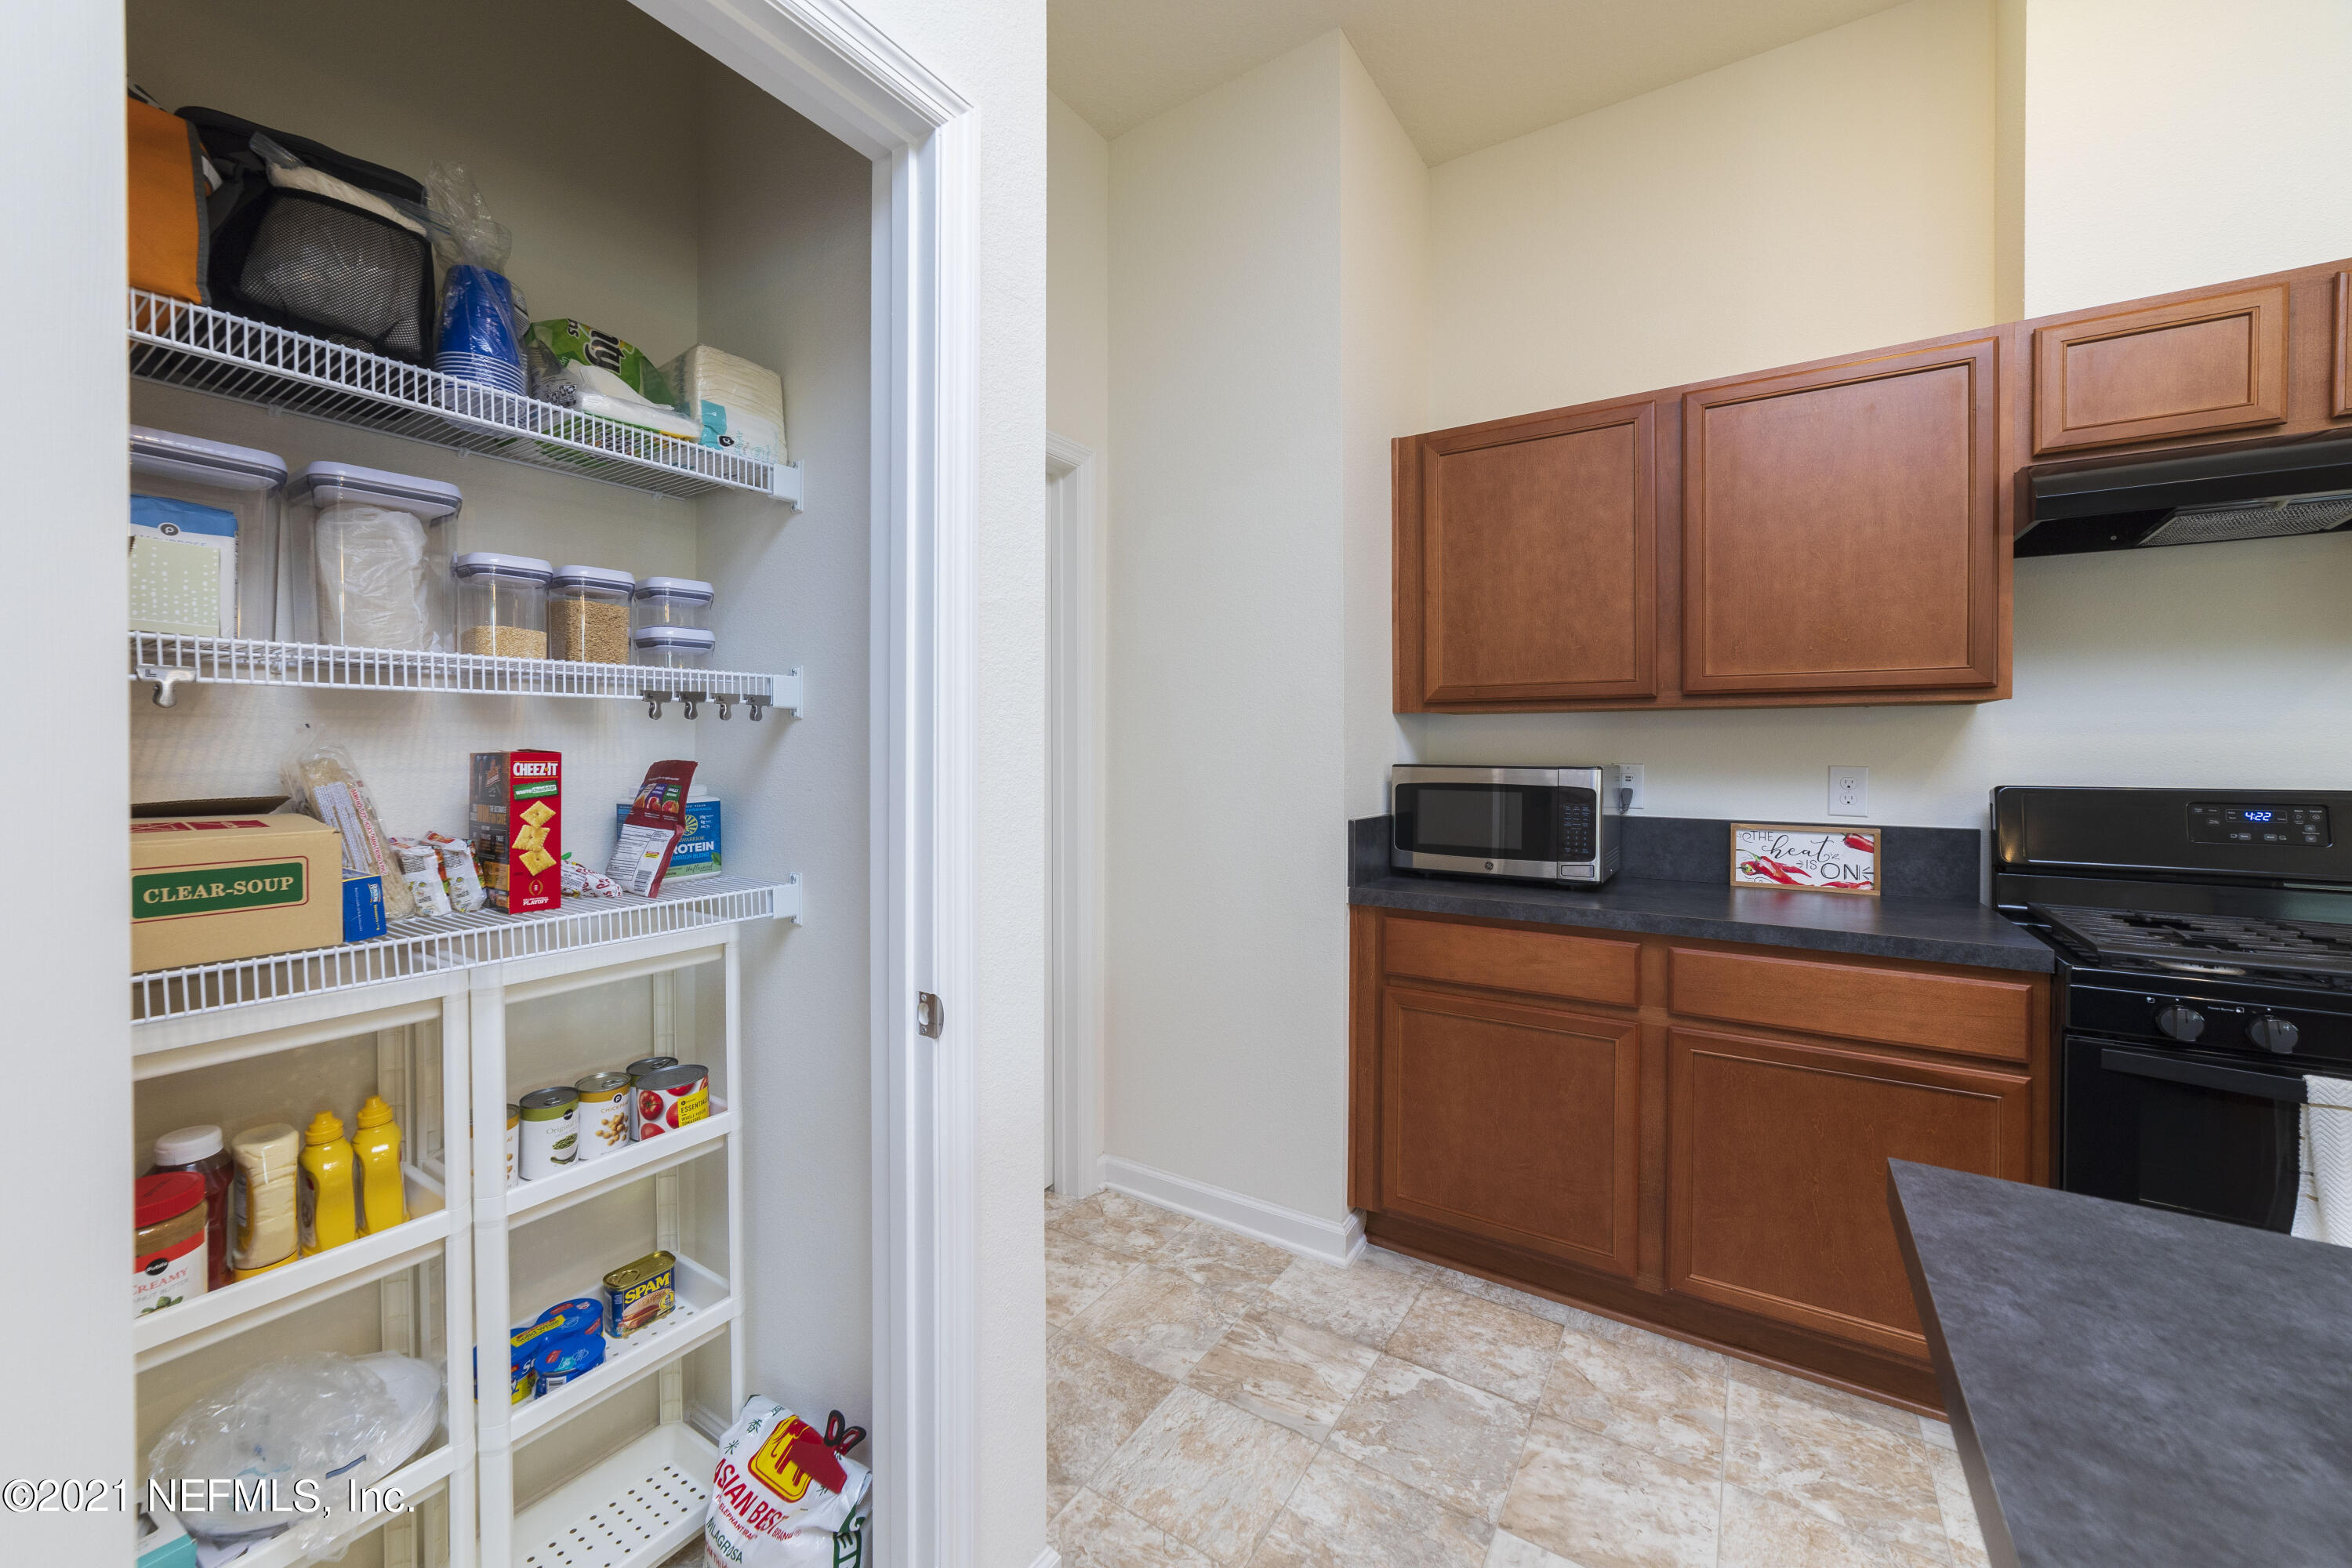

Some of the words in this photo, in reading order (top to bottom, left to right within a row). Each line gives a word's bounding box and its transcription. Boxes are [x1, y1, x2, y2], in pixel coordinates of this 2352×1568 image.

[2245, 811, 2271, 822] 4:22
[673, 841, 714, 855] OTEIN
[1750, 830, 1774, 841] THE
[1762, 834, 1835, 862] heat
[1806, 859, 1817, 869] IS
[1820, 862, 1860, 880] ON
[143, 877, 294, 904] CLEAR-SOUP
[624, 1272, 670, 1304] SPAM
[719, 1502, 745, 1533] ELEPHANT
[746, 1500, 789, 1534] BEST
